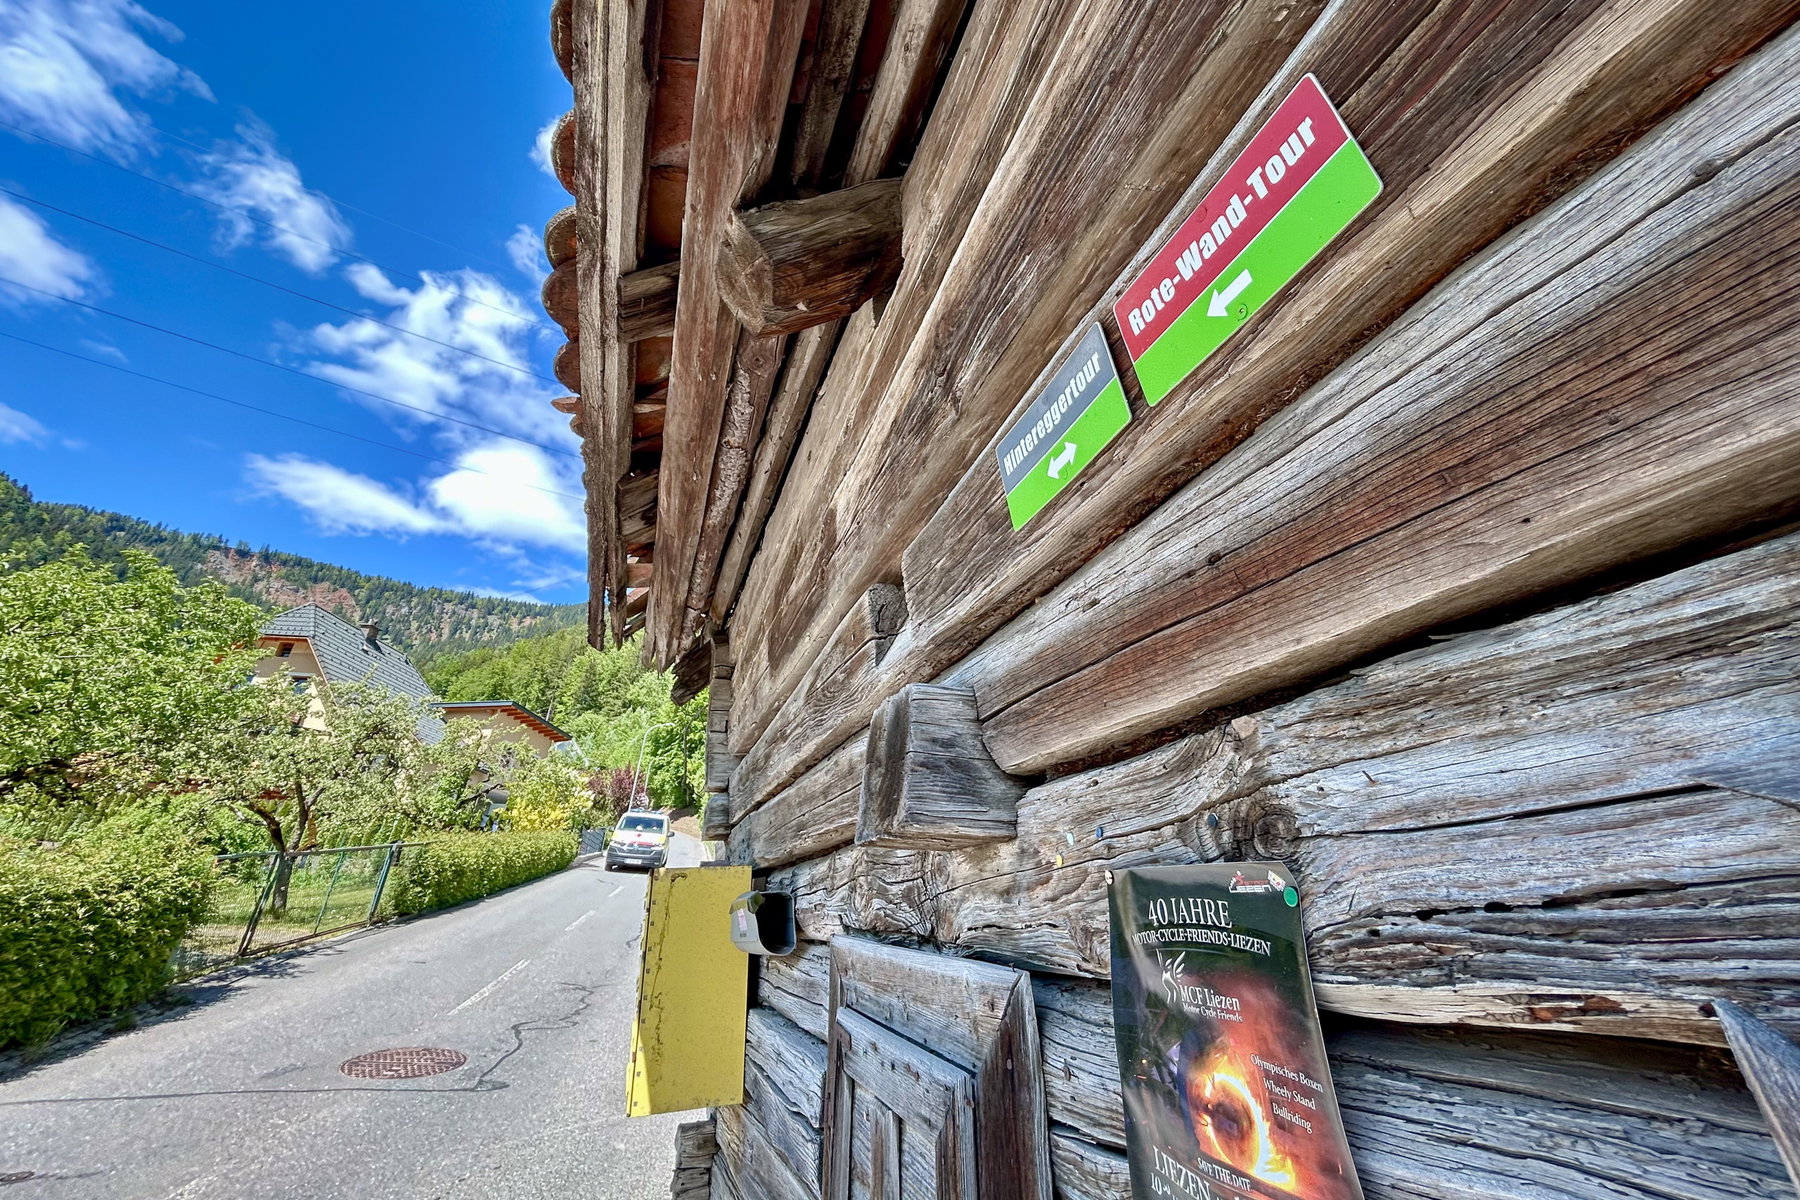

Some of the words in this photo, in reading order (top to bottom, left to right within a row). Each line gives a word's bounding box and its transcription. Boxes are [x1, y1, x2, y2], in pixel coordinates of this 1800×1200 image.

[1127, 115, 1317, 336] Rote-Wand-Tour
[1003, 352, 1101, 476] Hintereggertour
[1148, 898, 1168, 927] 40
[1170, 897, 1233, 928] JAHRE
[1179, 985, 1203, 1005] MCF
[1204, 988, 1241, 1011] Liezen
[1182, 1002, 1200, 1015] Motor
[1200, 1006, 1217, 1020] Cycle
[1217, 1010, 1243, 1023] Friends
[1250, 1054, 1299, 1082] Olympisches
[1299, 1072, 1323, 1093] Boxen
[1263, 1077, 1292, 1102] Wheely
[1293, 1090, 1316, 1110] Stand
[1272, 1102, 1312, 1134] Bullriding
[1152, 1144, 1211, 1200] LIEZEN
[1197, 1157, 1214, 1177] SAVE
[1212, 1164, 1232, 1184] THE
[1231, 1173, 1252, 1192] DATE
